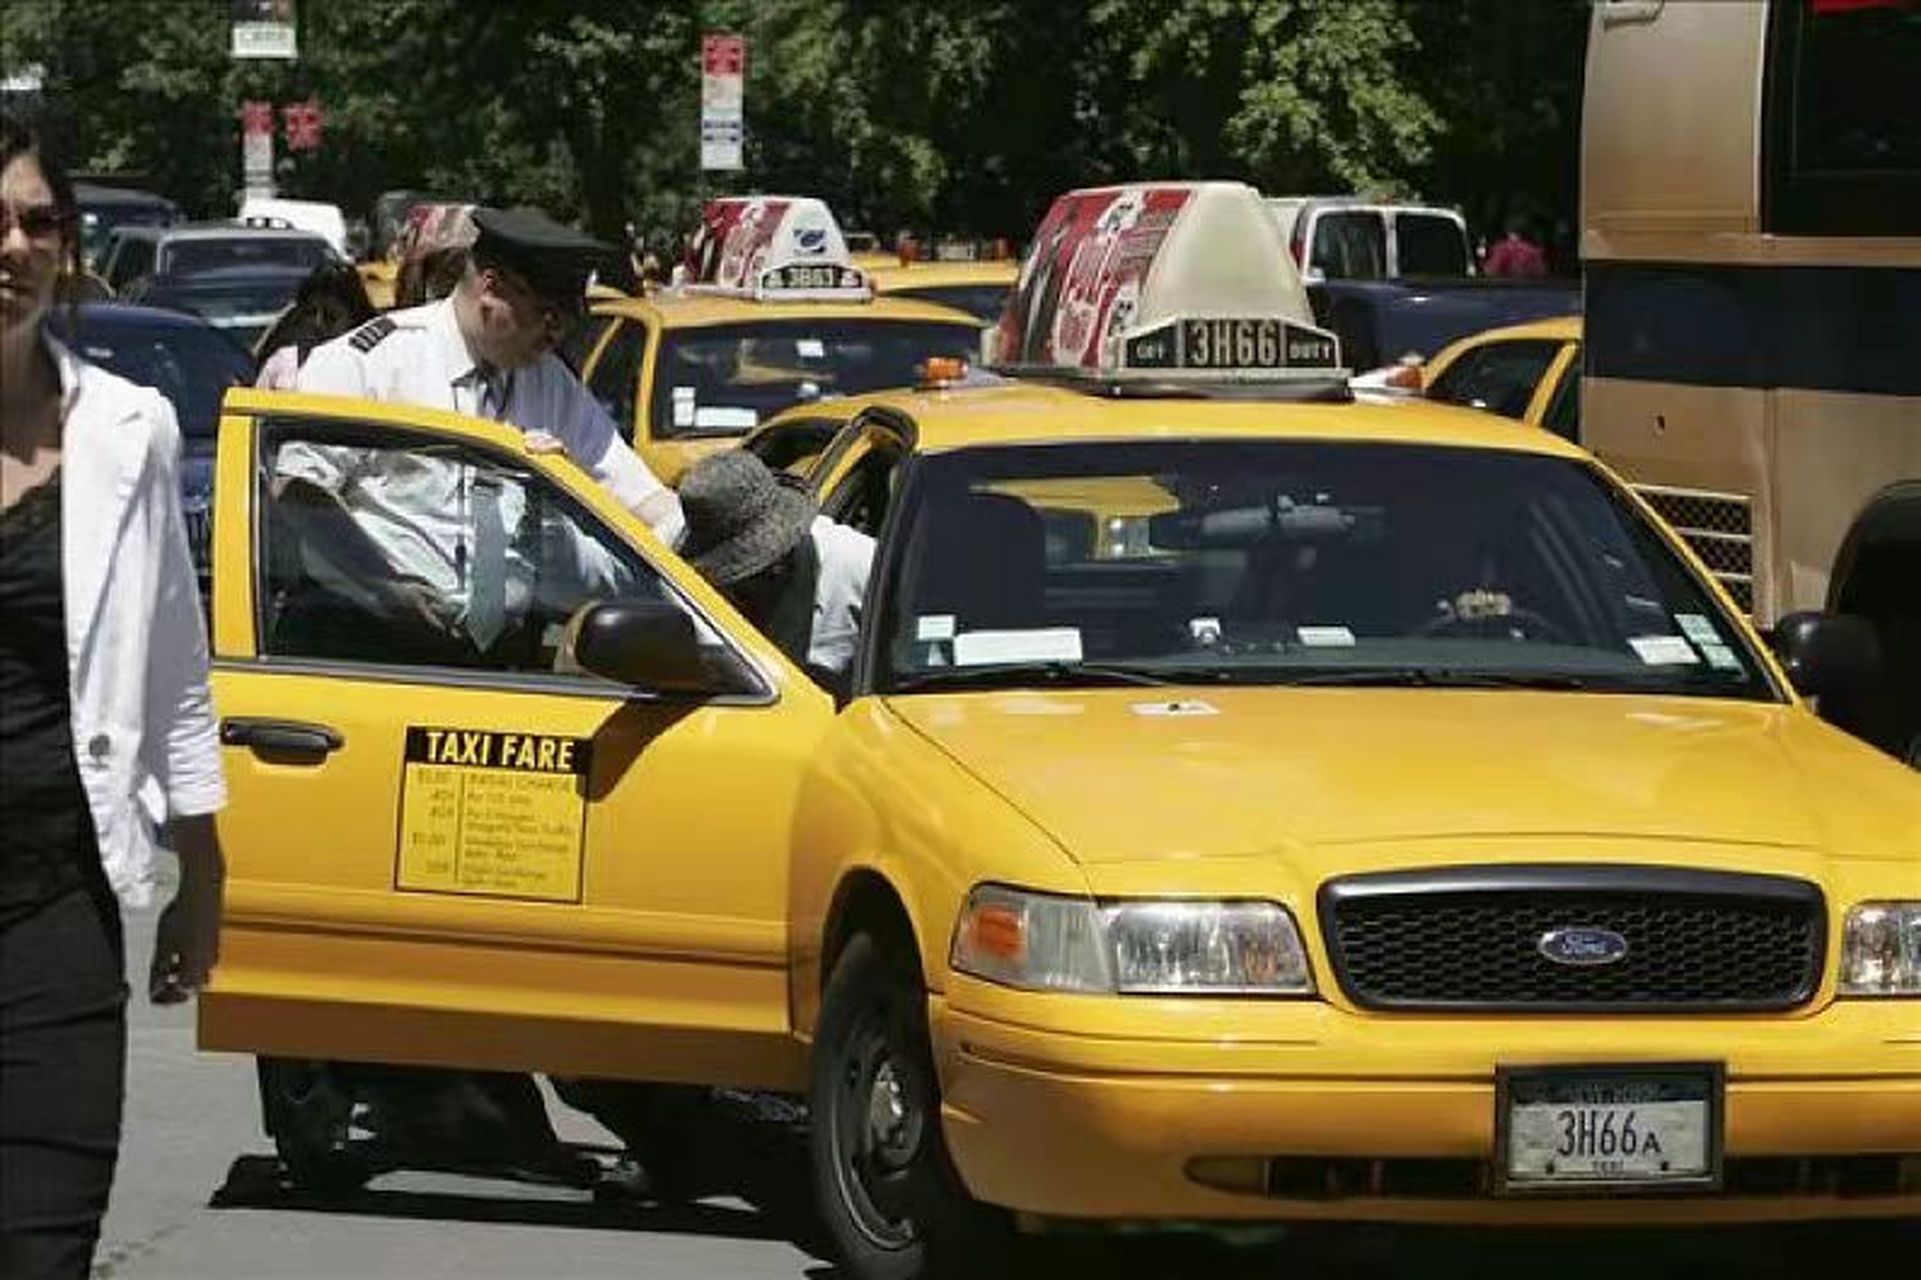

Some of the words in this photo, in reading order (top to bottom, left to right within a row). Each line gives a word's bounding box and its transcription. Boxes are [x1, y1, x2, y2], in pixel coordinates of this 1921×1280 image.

[1190, 320, 1277, 366] 3H66
[425, 731, 493, 766] TAXI
[501, 735, 575, 770] FARE
